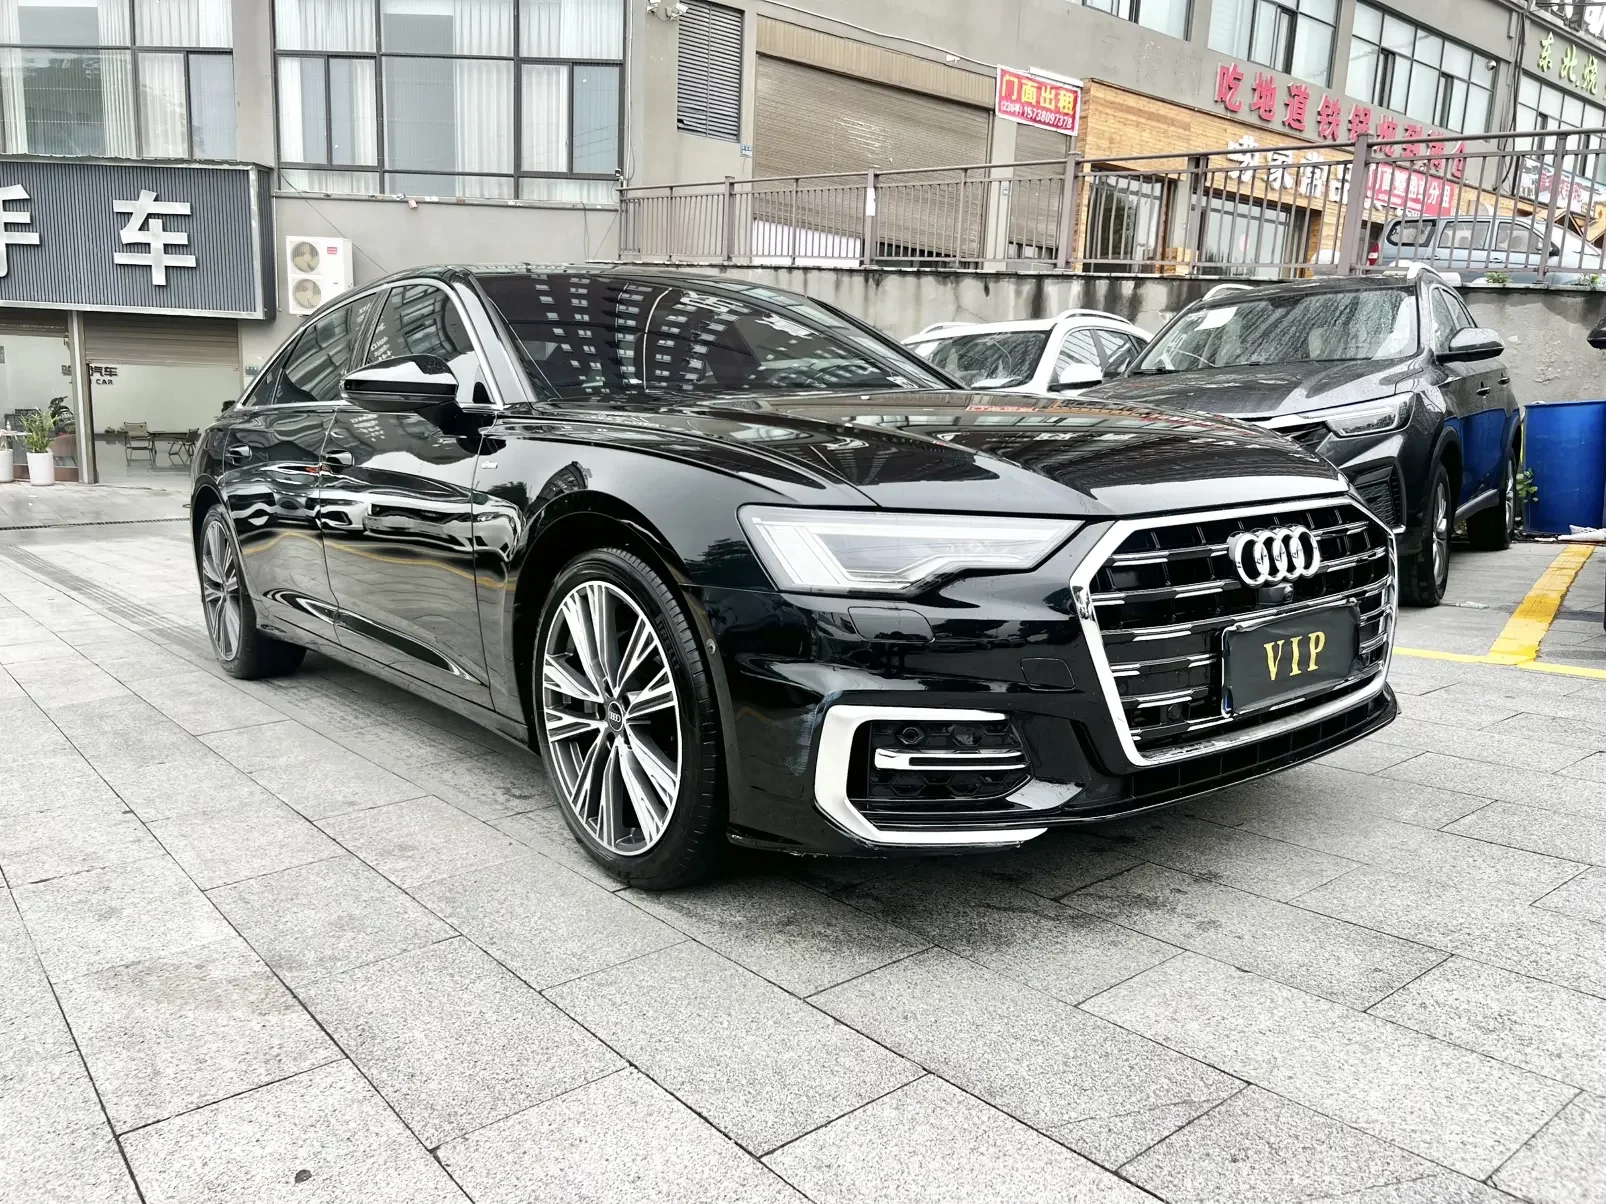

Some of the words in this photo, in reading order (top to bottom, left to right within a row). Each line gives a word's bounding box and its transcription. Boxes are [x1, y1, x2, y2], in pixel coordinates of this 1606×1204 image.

[1001, 73, 1075, 115] 门面出租
[1023, 106, 1073, 129] 15738097378
[1263, 630, 1326, 681] VIP
